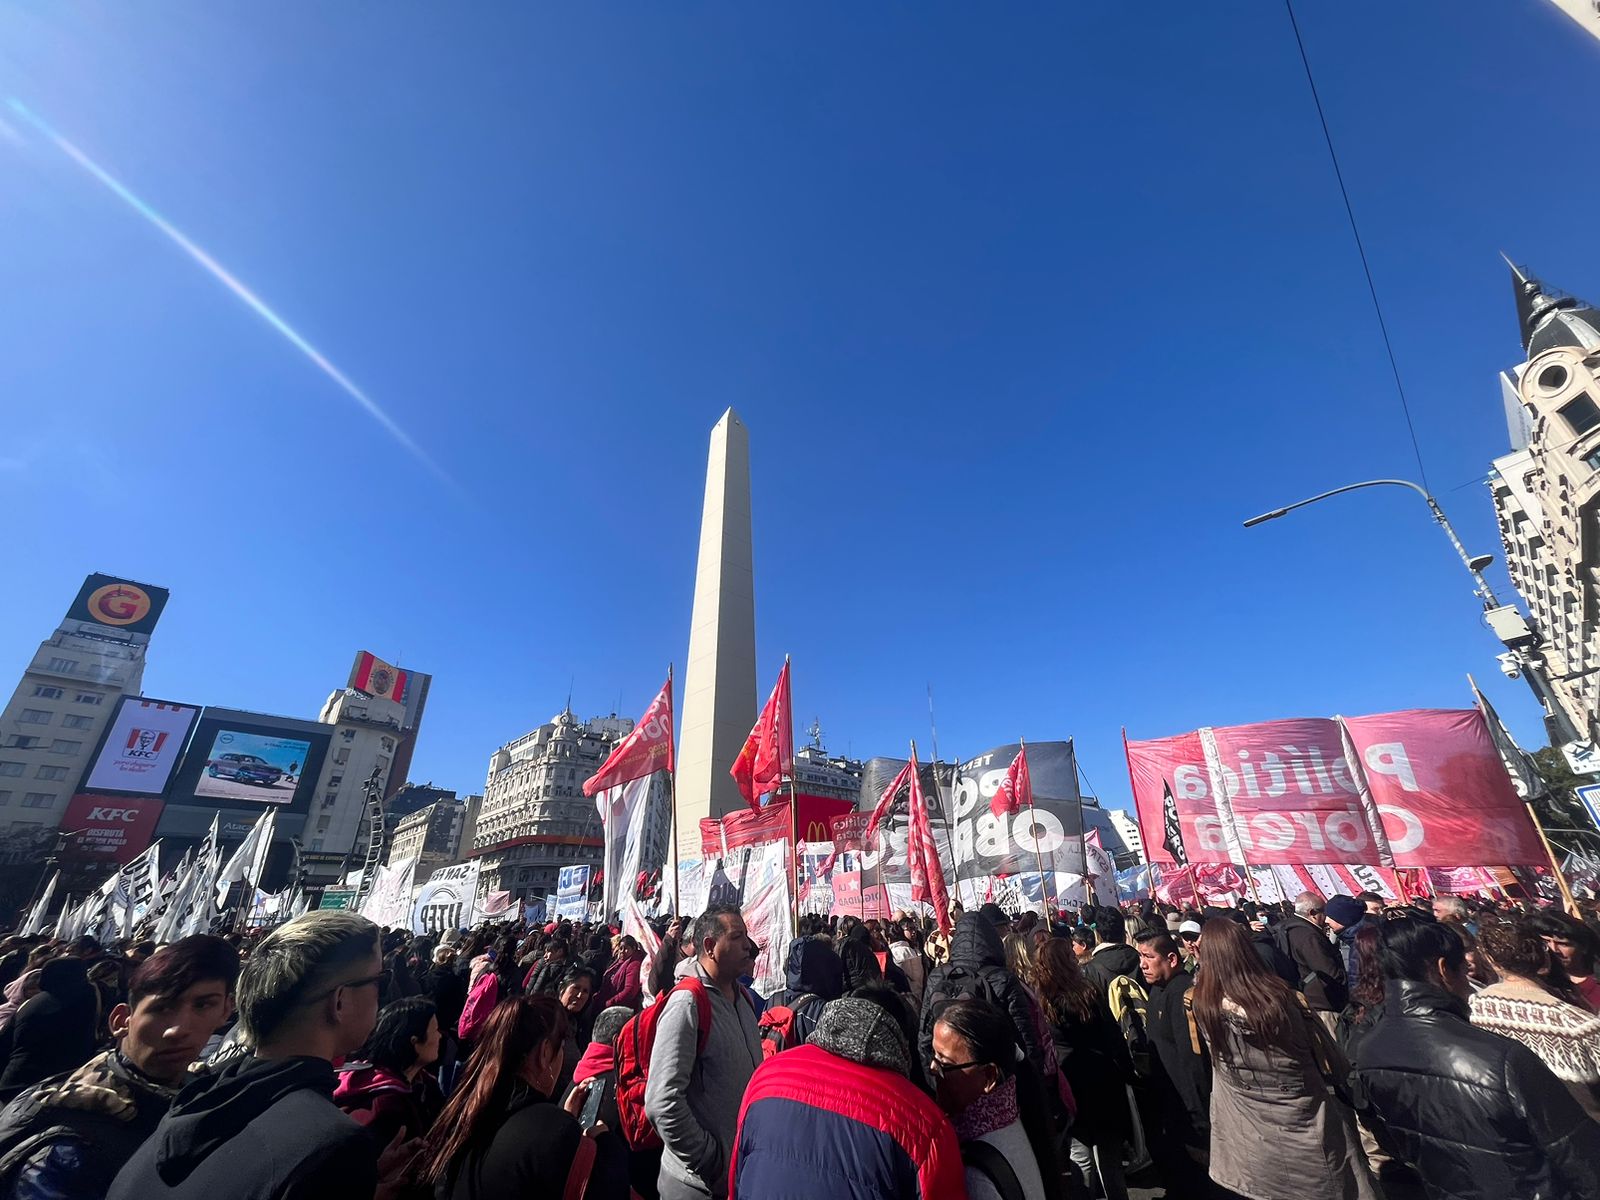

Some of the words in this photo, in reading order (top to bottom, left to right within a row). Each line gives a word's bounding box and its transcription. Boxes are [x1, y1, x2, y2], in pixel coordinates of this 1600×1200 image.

[98, 589, 141, 620] G
[127, 750, 154, 759] KFC
[86, 807, 139, 822] KFC
